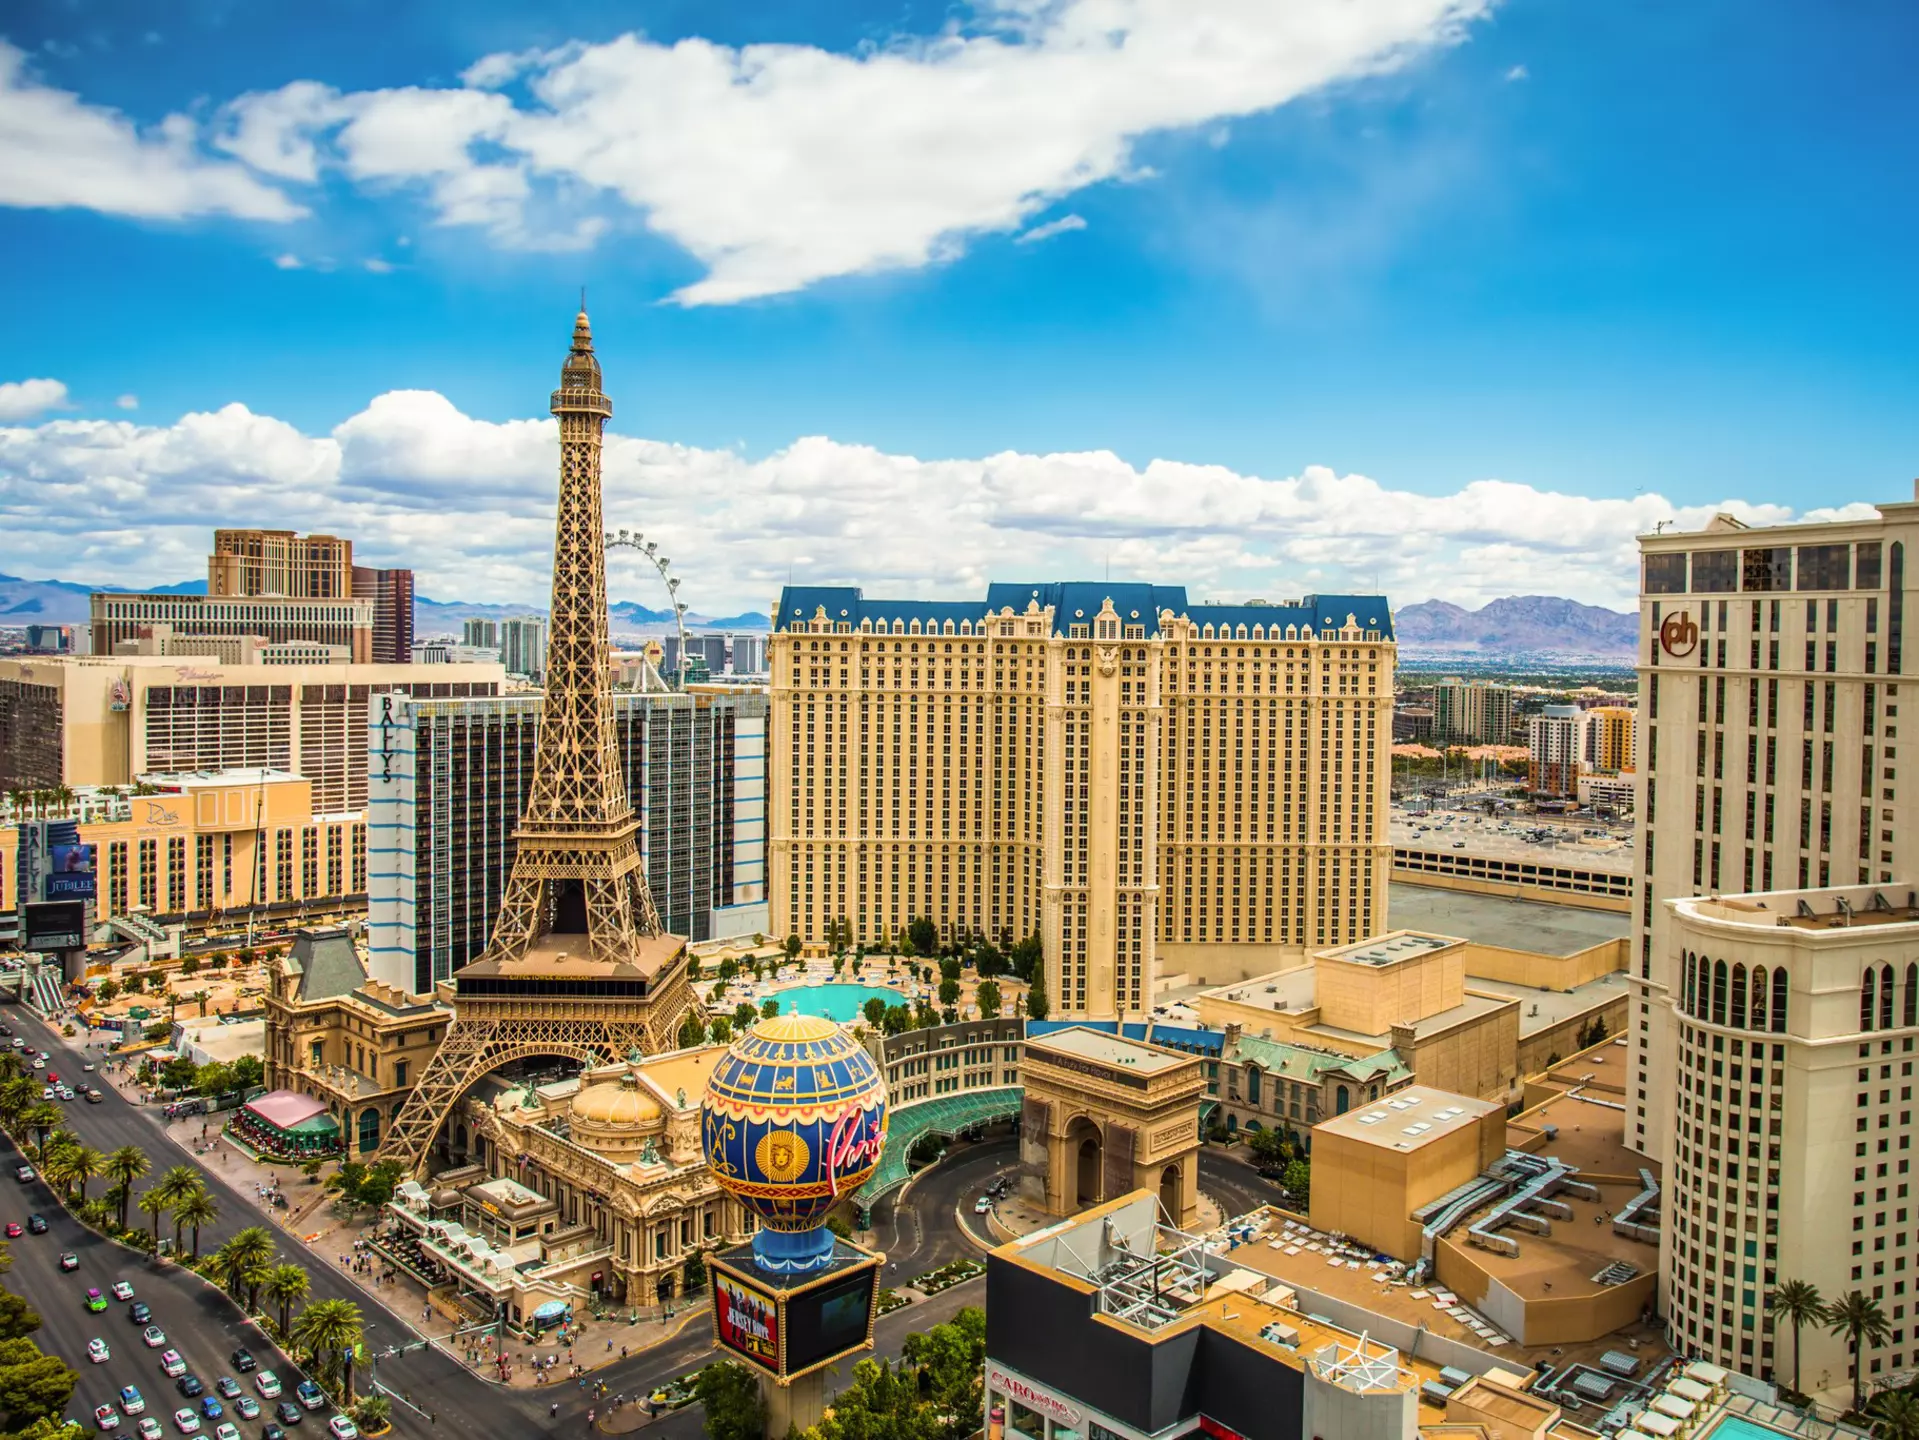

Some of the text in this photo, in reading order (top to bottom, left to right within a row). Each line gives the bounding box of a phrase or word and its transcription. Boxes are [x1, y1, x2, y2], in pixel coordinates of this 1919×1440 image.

[1663, 611, 1698, 655] ph
[48, 880, 94, 894] JUBILEE
[826, 1104, 887, 1197] Paris
[727, 1306, 752, 1333] JERSEY
[991, 1371, 1035, 1402] CABO
